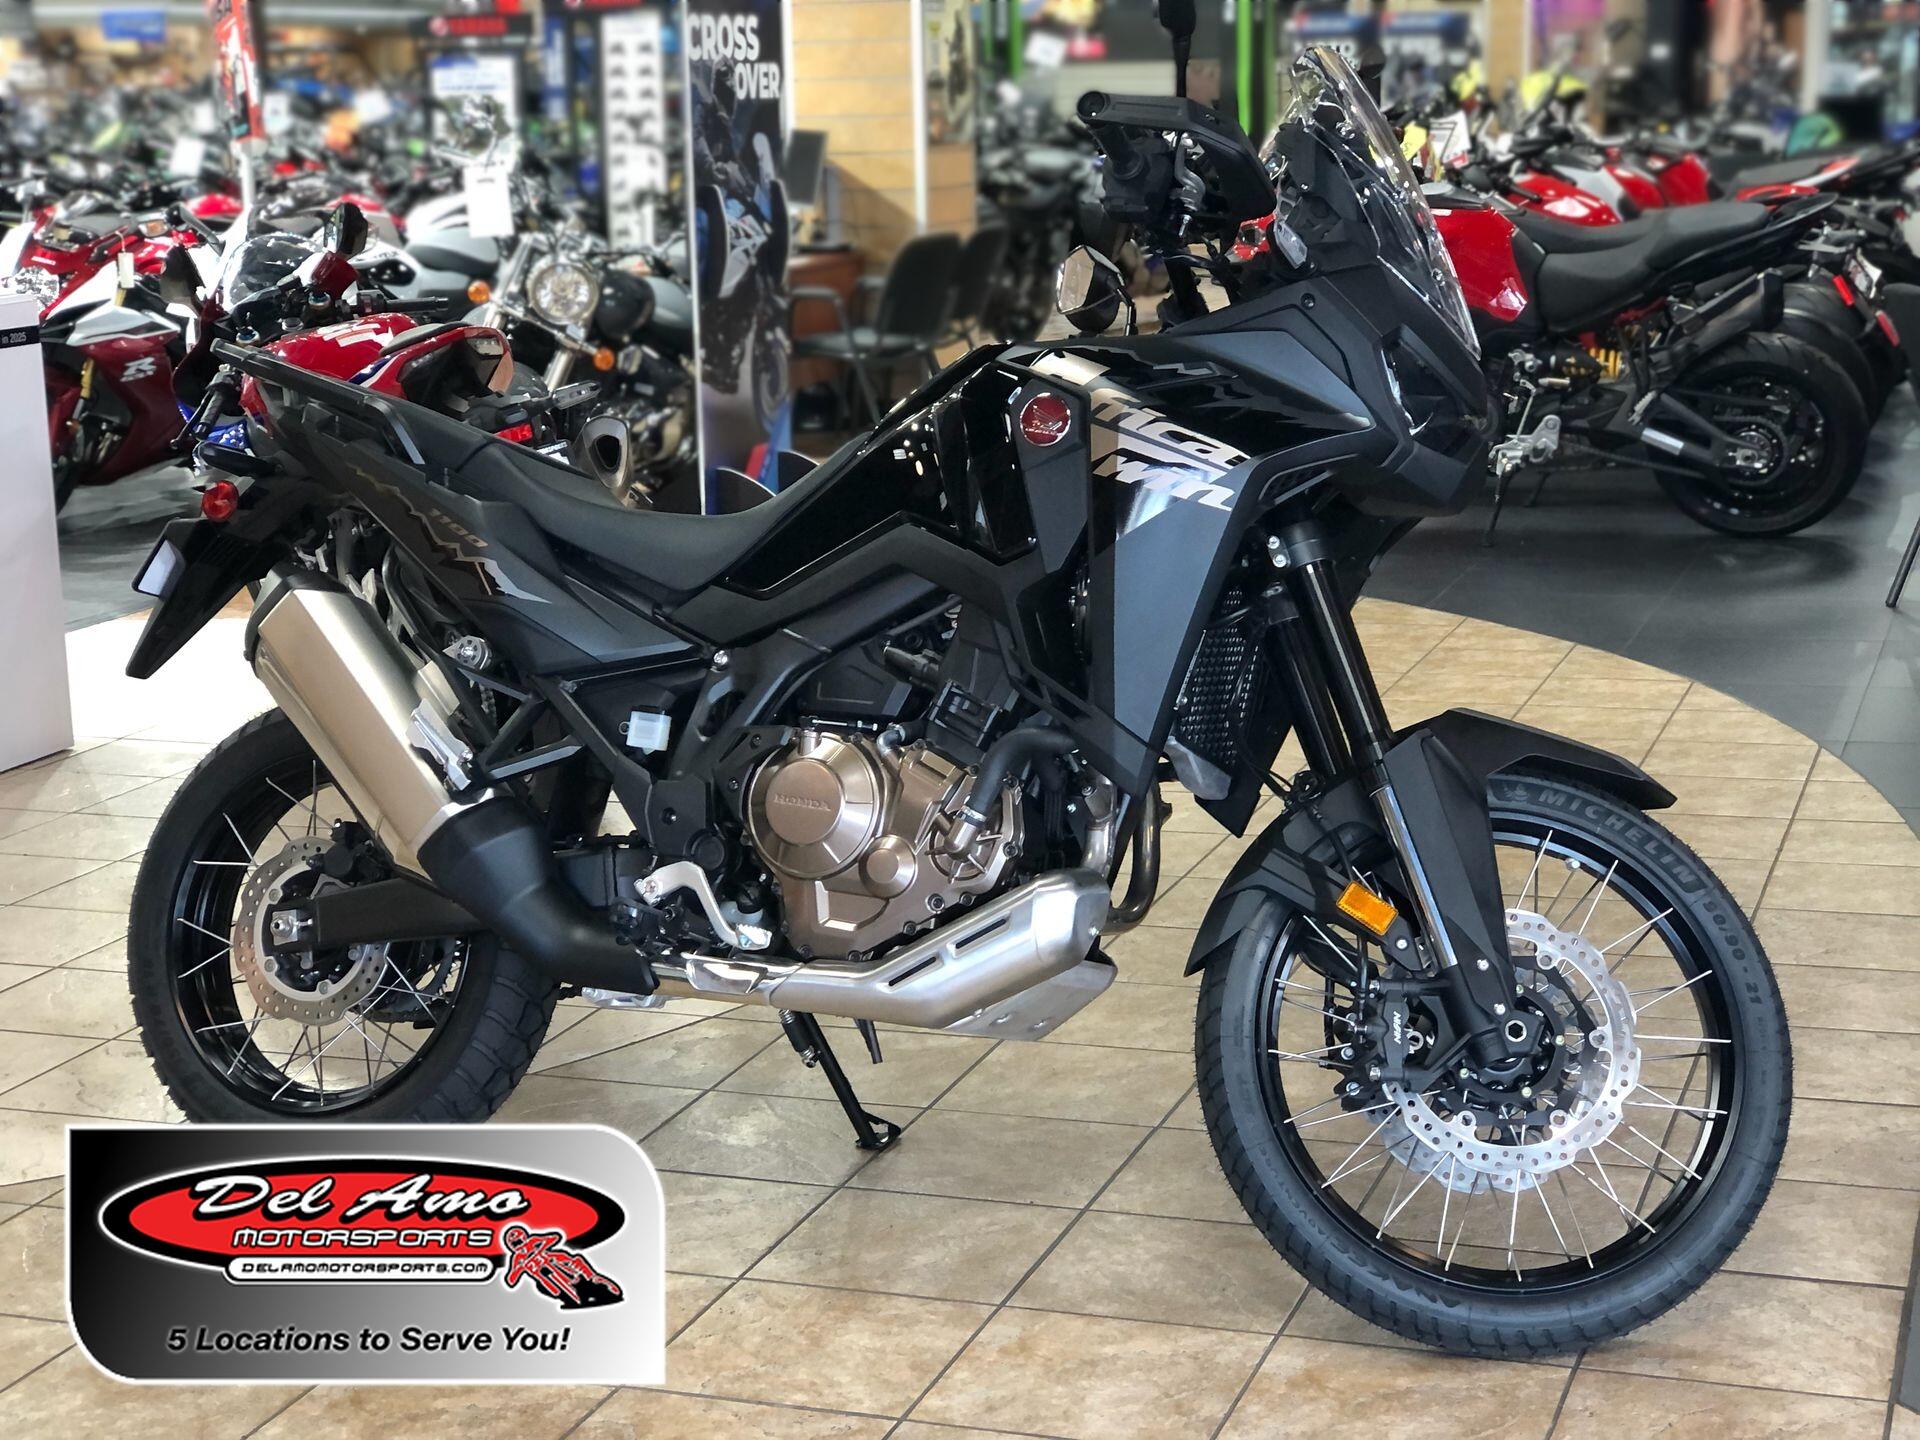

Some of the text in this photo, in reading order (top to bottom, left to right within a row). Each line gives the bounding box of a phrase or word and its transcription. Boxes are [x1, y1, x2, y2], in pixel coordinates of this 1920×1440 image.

[688, 13, 760, 61] CROSS
[734, 61, 781, 100] OVER
[430, 508, 489, 548] 1100
[773, 793, 832, 812] HONDA
[1537, 789, 1696, 885] MICHELIN
